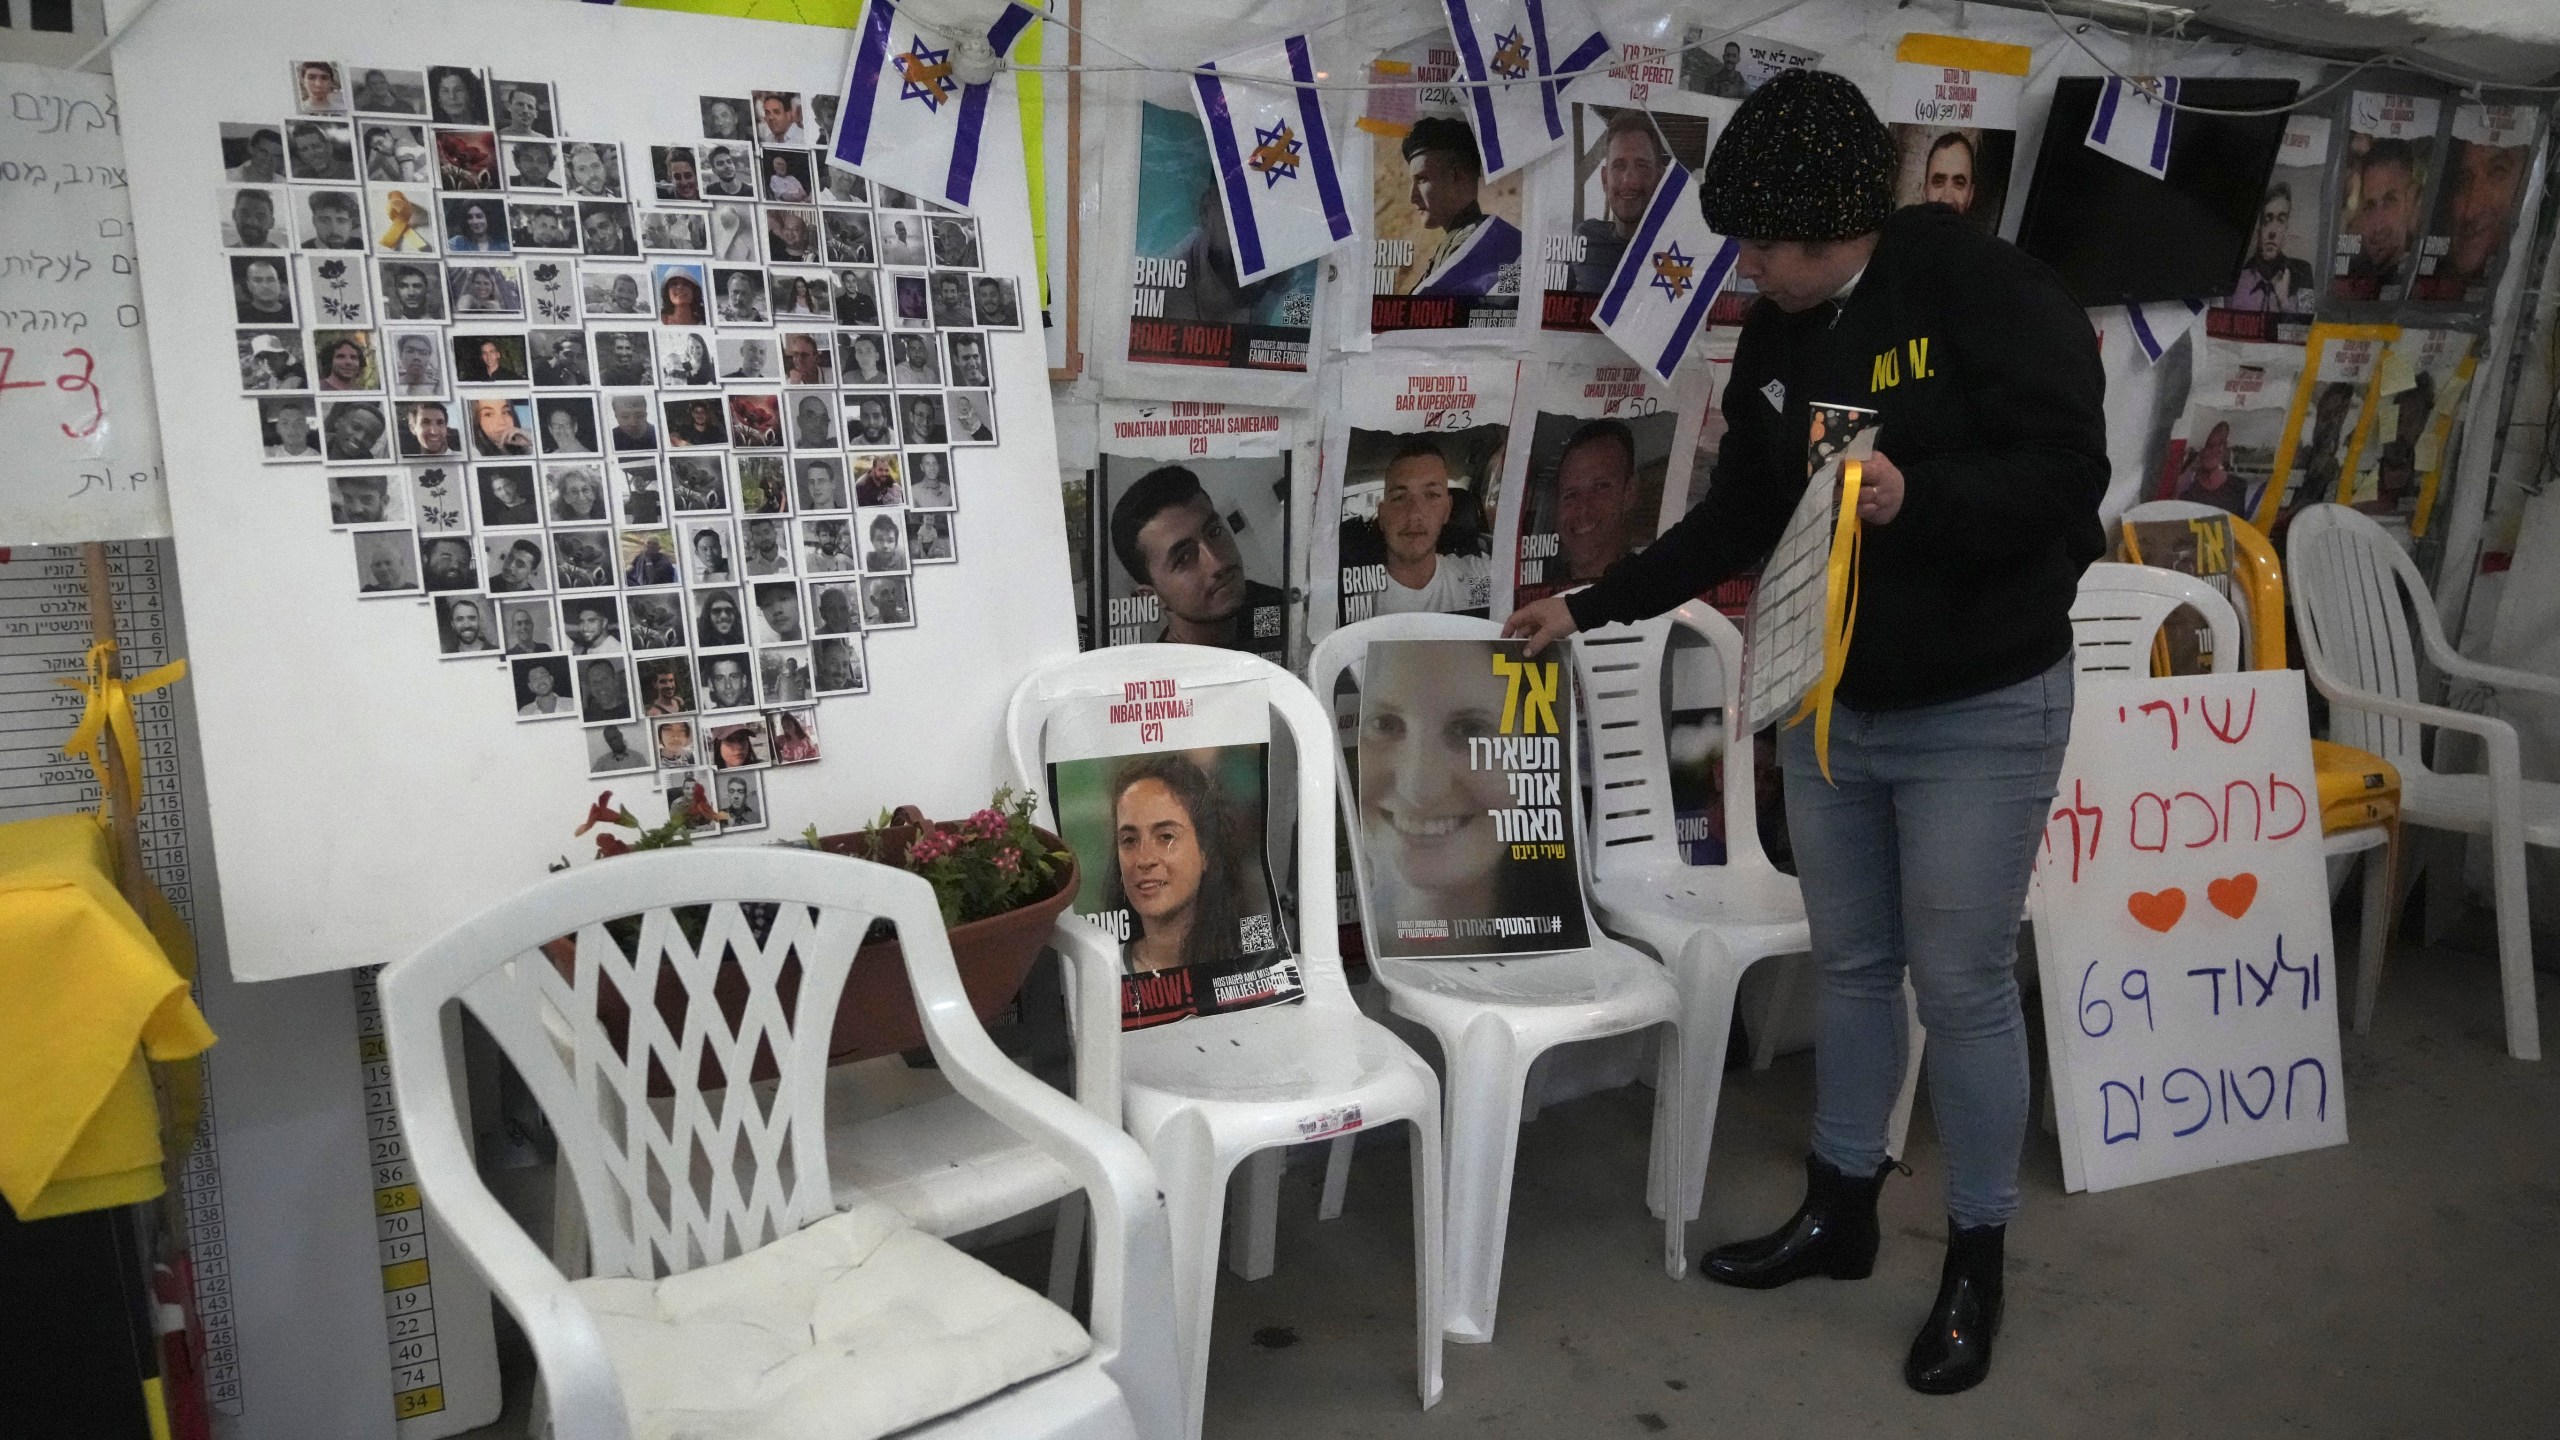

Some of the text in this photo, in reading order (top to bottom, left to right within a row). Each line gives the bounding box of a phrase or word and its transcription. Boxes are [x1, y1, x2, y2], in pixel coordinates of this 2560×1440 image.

[1641, 66, 1674, 85] PERETZ
[1935, 84, 1947, 100] TAL
[1134, 257, 1187, 288] BRING
[1131, 288, 1165, 318] HIM
[1373, 298, 1454, 327] OME NOW!
[1131, 320, 1232, 357] HOME NOW!
[1249, 349, 1282, 363] FAMILIES
[1396, 393, 1476, 411] BAR KUPERSHTEIN
[1630, 397, 1658, 419] 50
[1114, 416, 1280, 439] YONATHAN MORDECHAI SAMERANO
[1447, 410, 1472, 429] 23
[1189, 436, 1208, 455] (21)
[1522, 533, 1559, 559] BRING
[2188, 518, 2227, 574] אל
[144, 559, 155, 572] 2
[1520, 559, 1543, 585] HIM
[146, 577, 157, 590] 3
[1343, 564, 1388, 594] BRING
[148, 596, 159, 608] 4
[1109, 595, 1160, 627] BRING
[150, 614, 161, 627] 5
[151, 632, 162, 646] 6
[153, 651, 163, 664] 7
[156, 687, 168, 700] 9
[1124, 679, 1176, 703] ענבר הימן
[1492, 654, 1559, 734] אל
[151, 705, 169, 718] 10
[1110, 703, 1142, 724] INBAR
[2119, 688, 2256, 751] שירי
[152, 723, 170, 736] 11
[1141, 722, 1164, 744] (27)
[154, 742, 173, 755] 12
[1468, 736, 1560, 771] תשאירו
[40, 760, 175, 786] 13 סלבסקי
[158, 778, 176, 791] 14
[1507, 772, 1561, 806] אותי
[159, 796, 178, 809] 15
[161, 814, 180, 828] 16
[1488, 808, 1564, 842] מאחור
[163, 833, 181, 846] 17
[165, 851, 184, 864] 18
[1512, 845, 1565, 860] שירי ביבס
[166, 869, 185, 882] 19
[168, 887, 187, 900] 20
[1137, 967, 1194, 1011] NOW!
[1212, 973, 1243, 988] HOSTAGES
[2078, 934, 2321, 1038] ולעוד 69
[1214, 982, 1256, 1003] FAMILIES
[371, 1091, 393, 1108] 21
[2100, 1057, 2327, 1144] חטופים
[374, 1115, 397, 1132] 75
[376, 1141, 400, 1159] 20
[194, 1155, 214, 1169] 35
[196, 1173, 216, 1187] 36
[379, 1166, 403, 1184] 86
[198, 1190, 217, 1205] 37
[382, 1192, 406, 1209] 28
[200, 1208, 220, 1222] 38
[202, 1226, 221, 1240] 39
[385, 1216, 409, 1234] 70
[203, 1243, 223, 1257] 40
[389, 1242, 411, 1260] 19
[205, 1261, 223, 1275] 41
[206, 1279, 226, 1293] 42
[208, 1296, 228, 1310] 43
[395, 1292, 417, 1310] 19
[210, 1314, 230, 1327] 44
[396, 1318, 420, 1336] 22
[211, 1331, 231, 1345] 45
[213, 1349, 233, 1362] 46
[398, 1343, 423, 1361] 40
[215, 1366, 234, 1380] 47
[402, 1368, 426, 1387] 74
[217, 1383, 236, 1398] 48
[404, 1394, 428, 1412] 34
